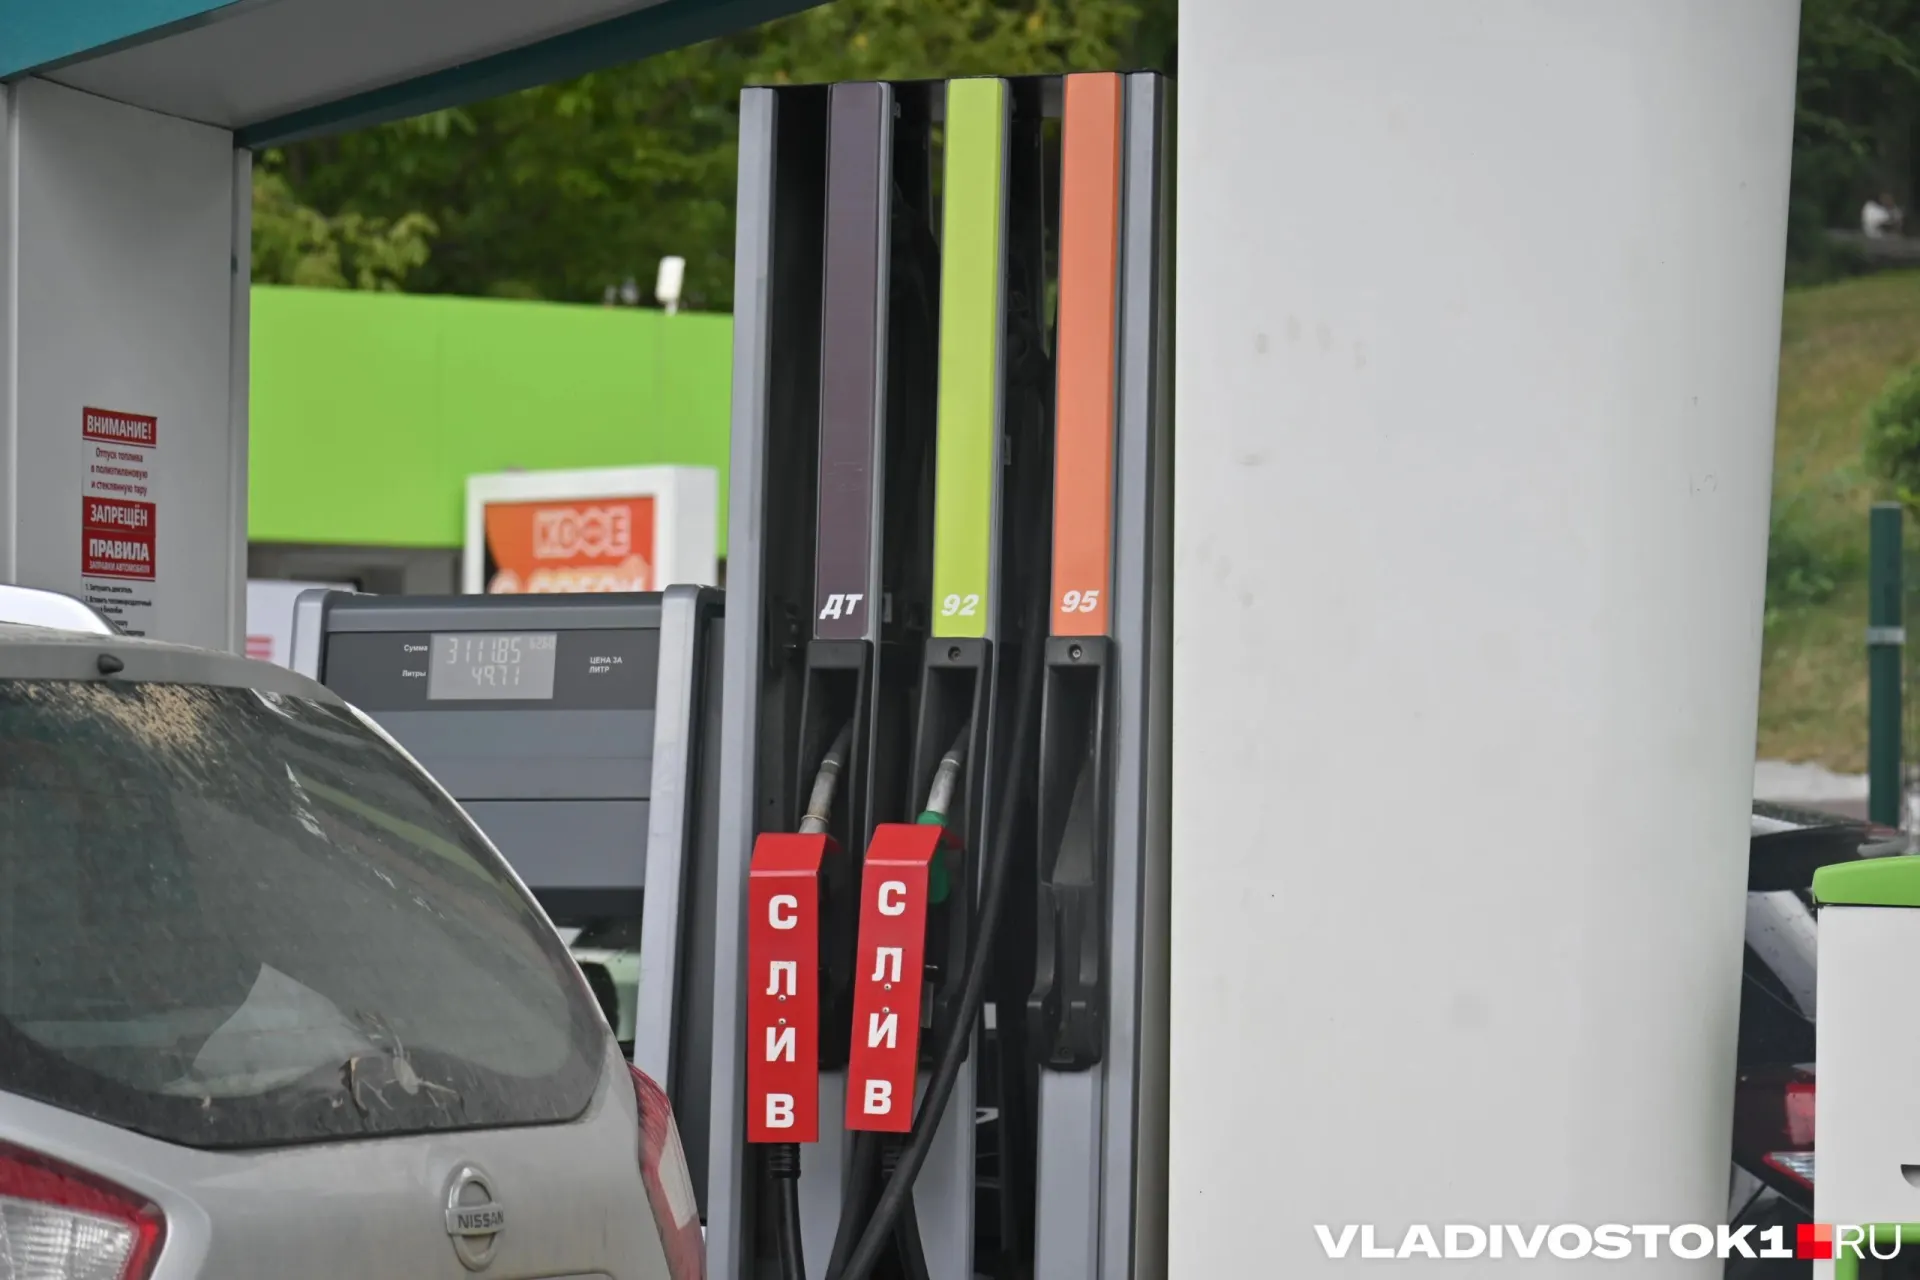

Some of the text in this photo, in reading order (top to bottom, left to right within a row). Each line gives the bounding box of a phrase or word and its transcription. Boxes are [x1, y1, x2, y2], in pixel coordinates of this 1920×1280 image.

[87, 415, 152, 440] ВНИМАНИЕ!
[95, 447, 143, 463] Отпуск топлива
[96, 481, 133, 495] стеклянную
[134, 484, 147, 497] тару
[90, 504, 148, 528] ЗАПРЕЩЁН
[533, 506, 631, 560] КОФЕ
[89, 538, 149, 561] ПРАВИЛА
[819, 593, 863, 620] ДТ
[941, 593, 979, 616] 92
[1060, 590, 1099, 613] 95
[403, 644, 428, 652] Сумма
[589, 666, 610, 674] ЛИТР
[590, 657, 609, 665] ЦЕНА
[402, 669, 427, 678] Литры
[863, 880, 907, 1115] СЛИВ
[765, 894, 799, 1129] СЛИВ
[457, 1211, 504, 1229] NISSAN
